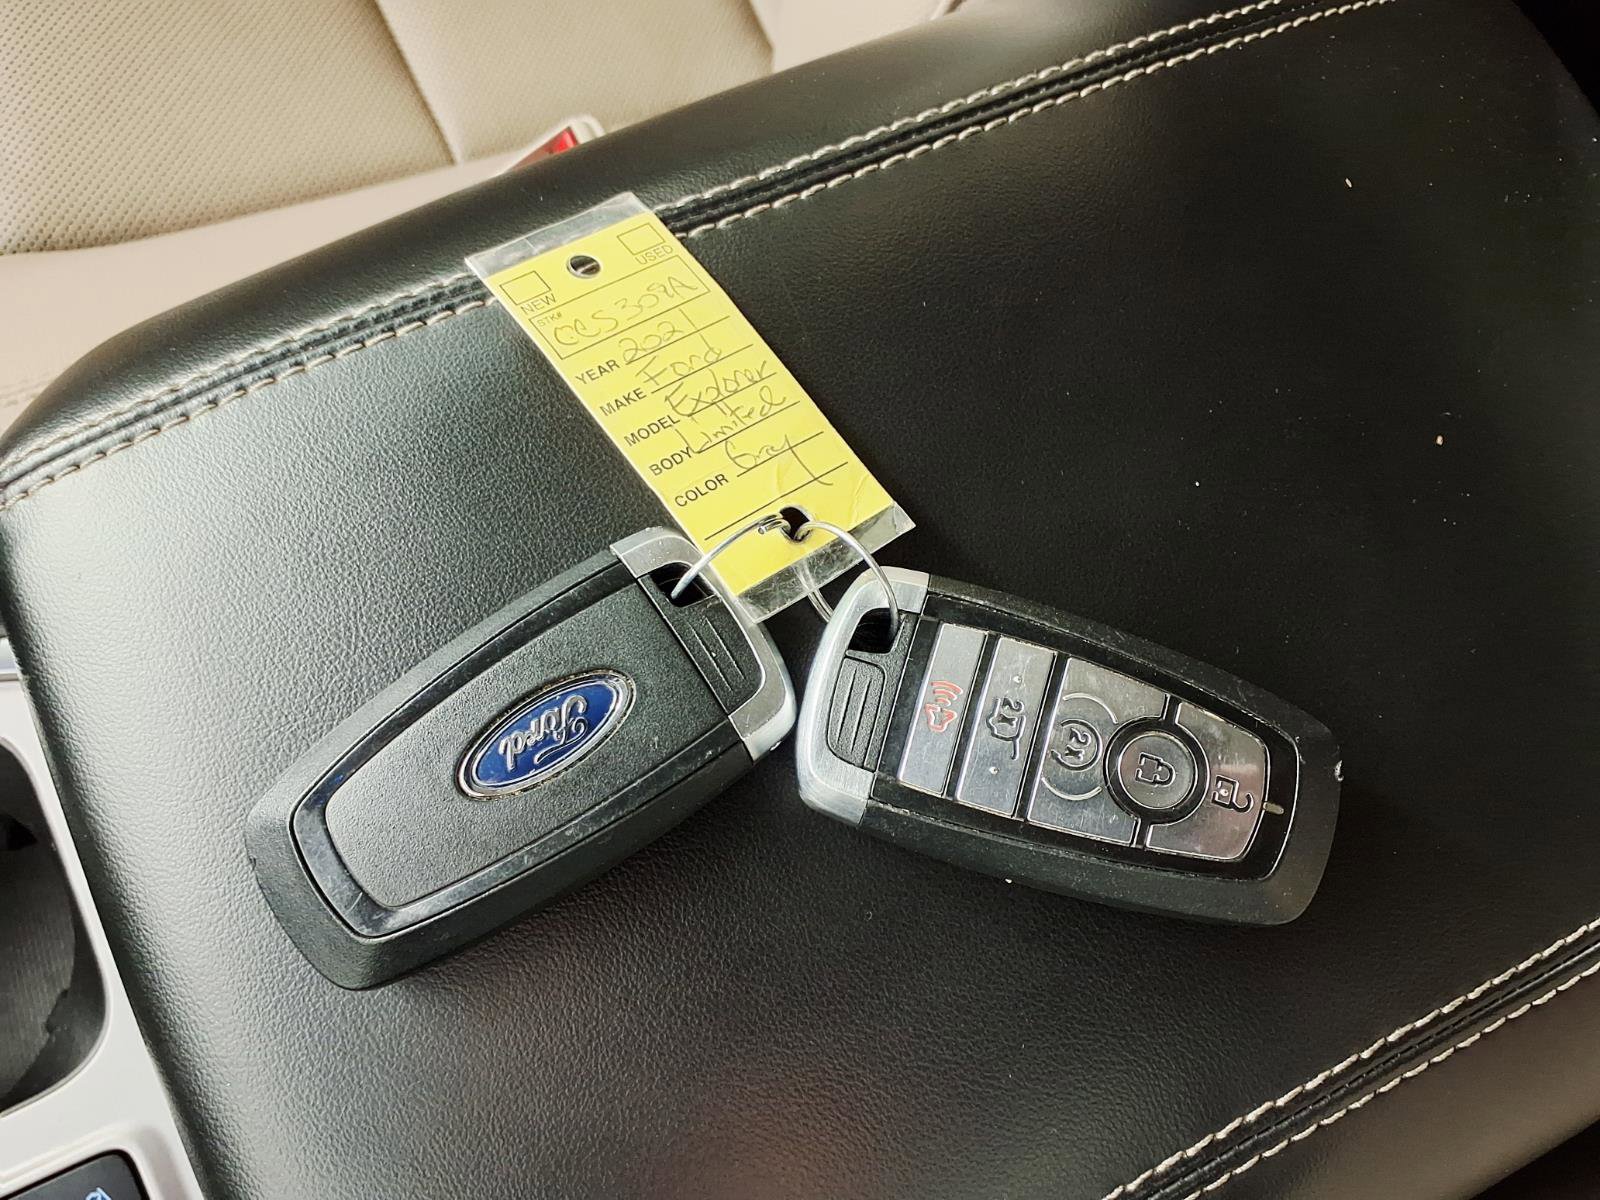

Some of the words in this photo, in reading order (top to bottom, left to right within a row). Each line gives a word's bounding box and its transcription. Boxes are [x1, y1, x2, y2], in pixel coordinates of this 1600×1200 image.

[635, 244, 674, 266] USED
[520, 292, 557, 316] NEW
[536, 312, 563, 328] STK#
[618, 308, 699, 363] 2021
[574, 359, 620, 386] YEAR
[635, 332, 723, 386] Ford
[599, 387, 647, 417] MAKE
[623, 414, 681, 447] MODEL
[673, 385, 787, 454] Limited
[649, 446, 693, 477] BODY
[724, 434, 834, 486] Gray
[674, 473, 729, 508] COLOR
[498, 694, 588, 772] Ford
